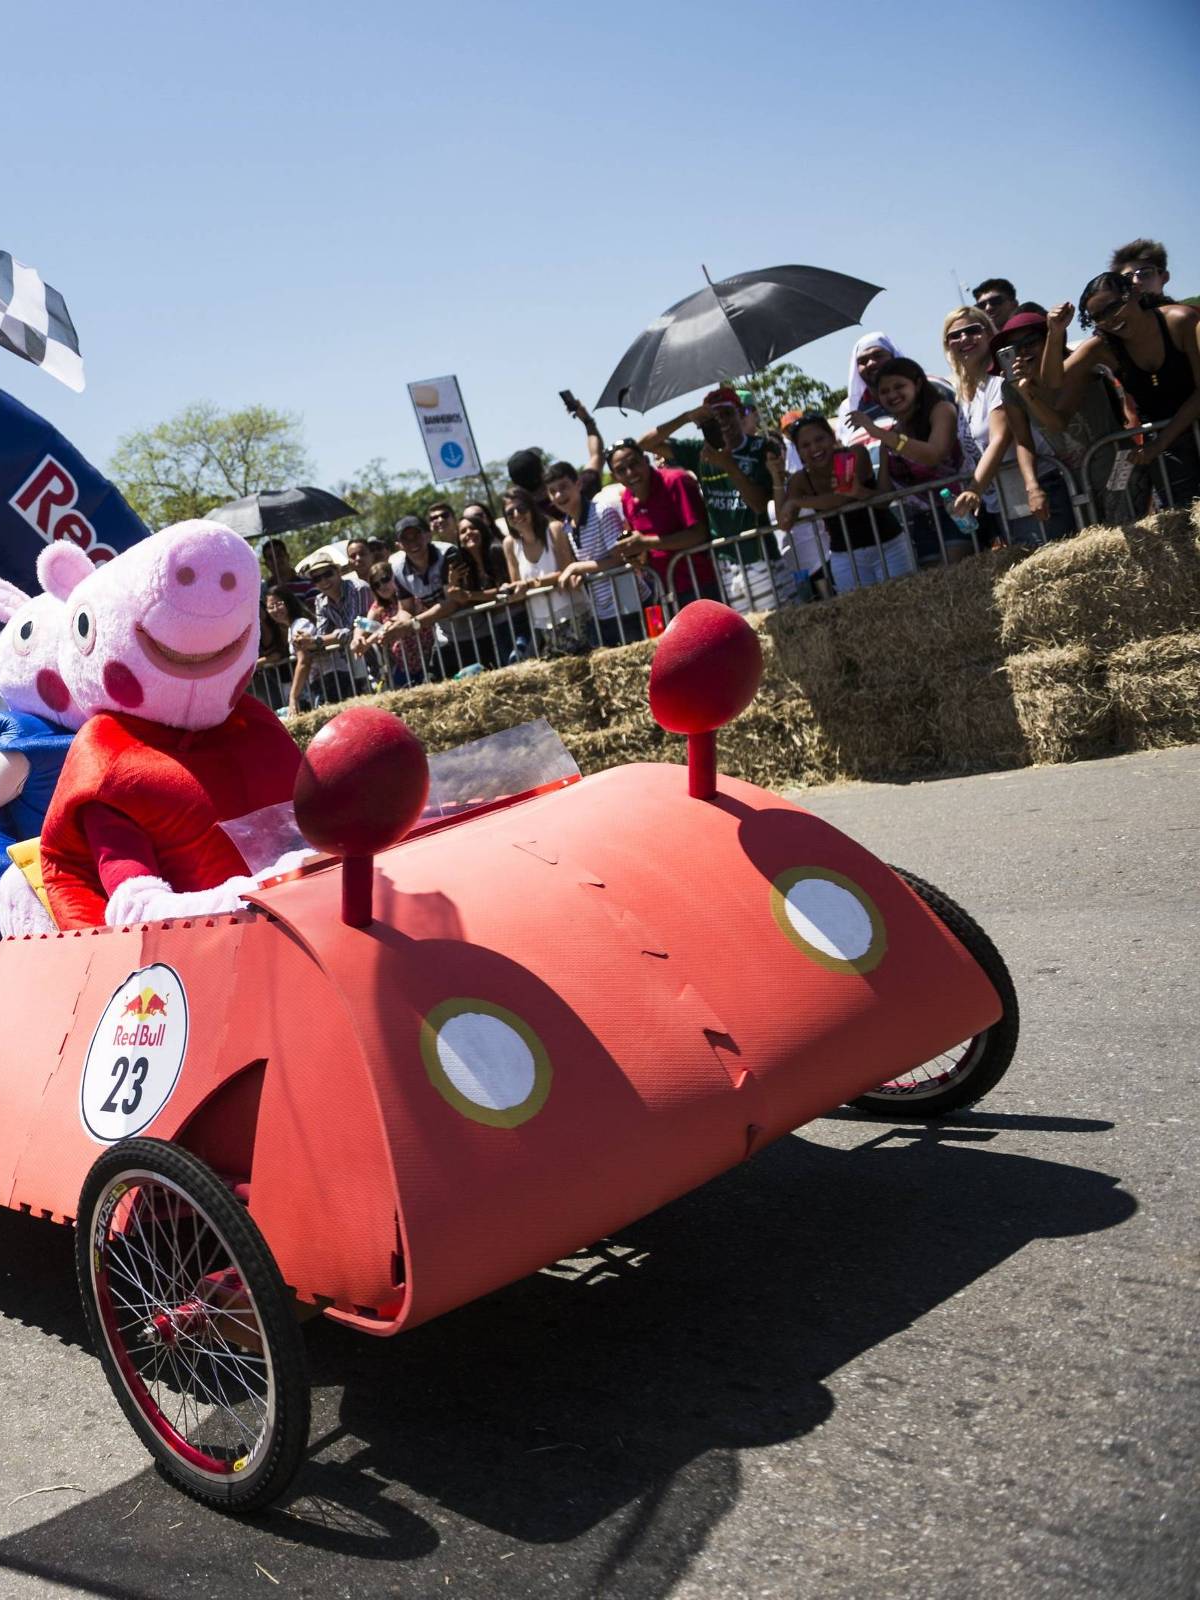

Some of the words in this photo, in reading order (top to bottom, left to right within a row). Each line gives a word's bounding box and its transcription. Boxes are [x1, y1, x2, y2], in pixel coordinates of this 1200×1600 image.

[112, 1023, 140, 1046] Red
[138, 1023, 166, 1047] Bull
[100, 1056, 149, 1115] 23
